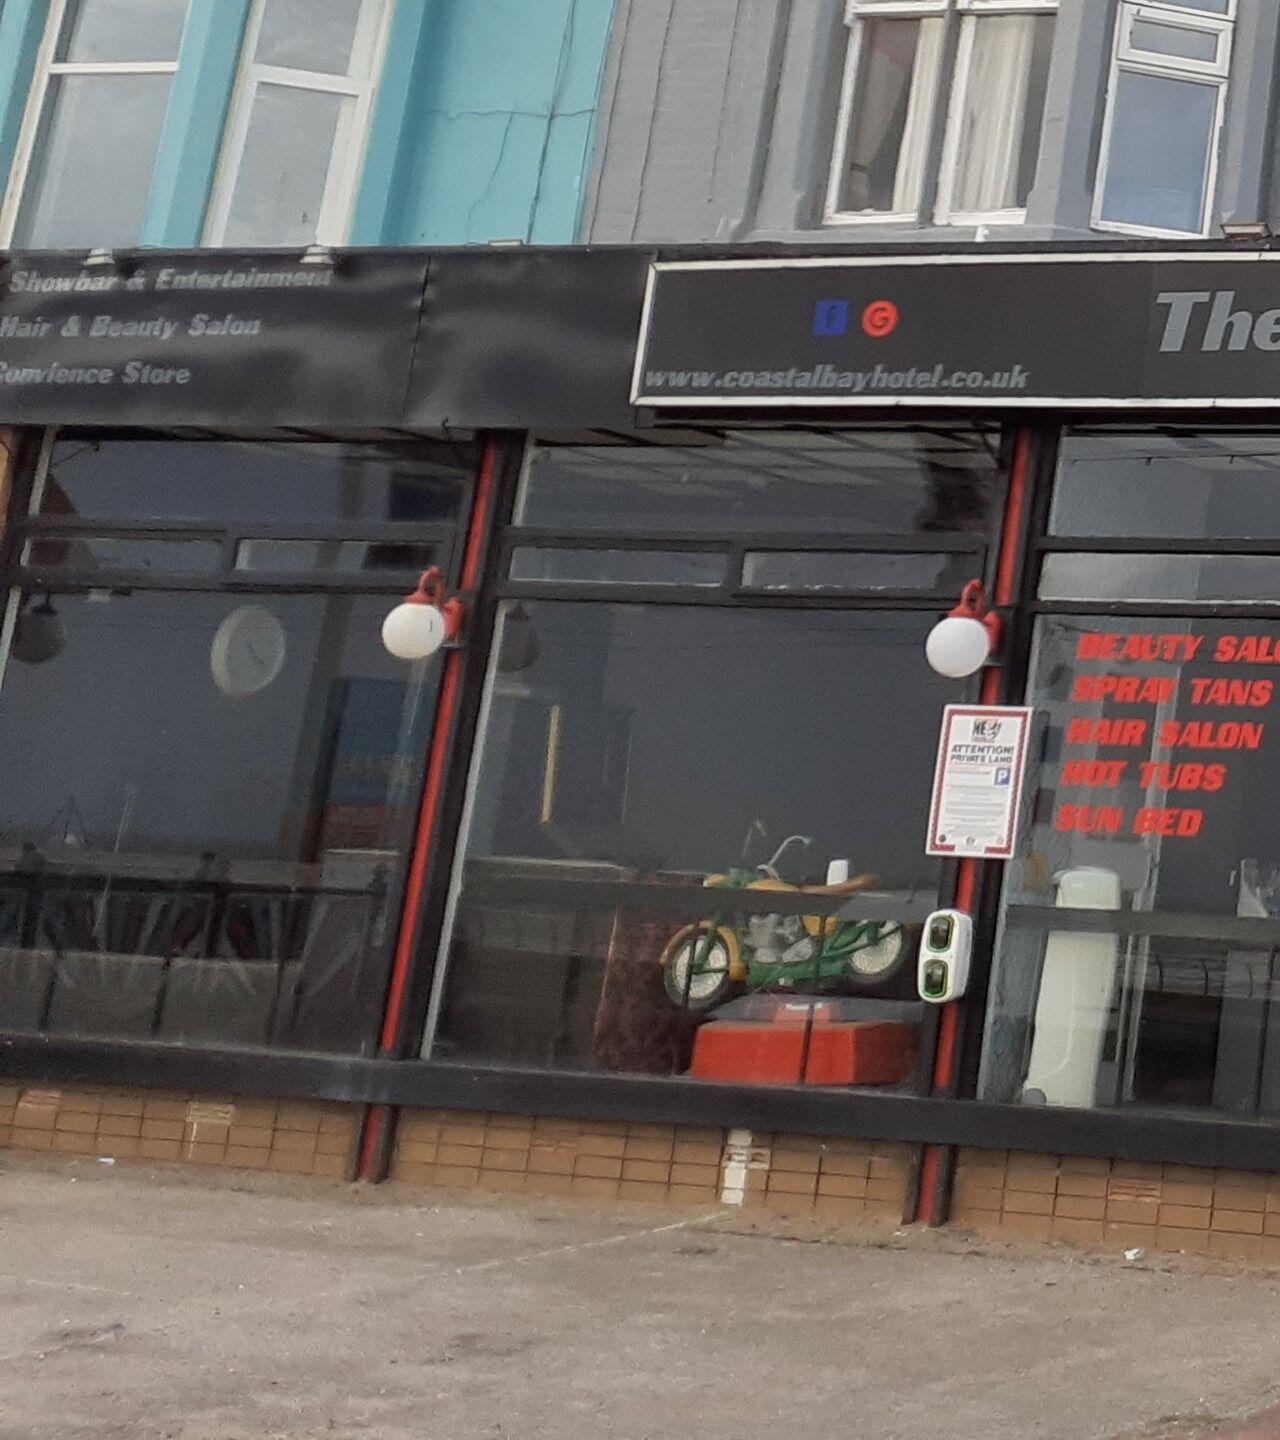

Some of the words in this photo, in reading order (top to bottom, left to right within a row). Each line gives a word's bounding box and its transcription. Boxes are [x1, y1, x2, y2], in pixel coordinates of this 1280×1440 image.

[9, 270, 118, 293] Showbar
[155, 268, 333, 291] Entertainment
[0, 315, 52, 338] Hair
[60, 316, 82, 337] &
[88, 315, 178, 341] Beauty
[187, 312, 262, 336] Salon
[121, 361, 191, 384] Store
[645, 364, 1030, 393] www.coastalbayhotel.co.uk
[1076, 633, 1204, 662] BEAUTY
[1070, 675, 1178, 703] SPRAY
[1190, 678, 1275, 707] TANS
[1065, 718, 1147, 746] HAIR
[1159, 720, 1265, 749] SALON
[1060, 761, 1129, 788] HOT
[1138, 763, 1228, 792] TUBS
[1055, 803, 1122, 833] SUN
[1133, 807, 1205, 838] BED
